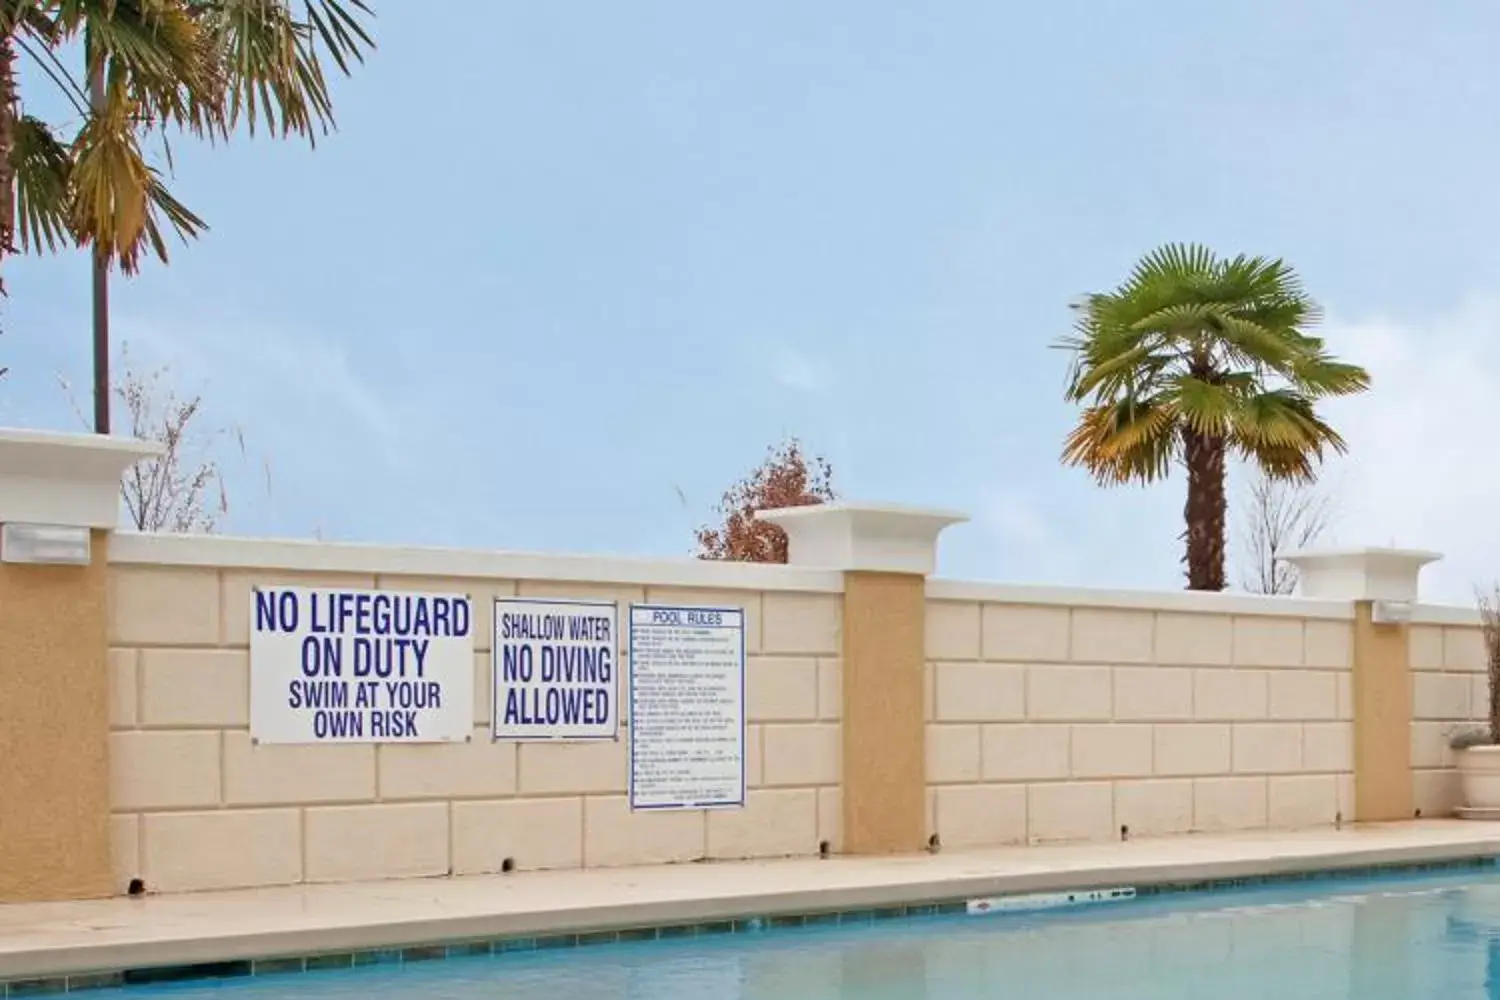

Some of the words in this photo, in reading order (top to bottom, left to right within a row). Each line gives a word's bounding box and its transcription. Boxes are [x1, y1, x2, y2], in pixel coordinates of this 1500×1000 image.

[256, 591, 299, 633] NO
[311, 593, 470, 637] LIFEGUARD
[502, 613, 565, 641] SHALLOW
[570, 616, 611, 642] WATER
[653, 611, 681, 625] POOL
[687, 611, 723, 625] RULES
[302, 635, 342, 677] ON
[354, 638, 429, 678] DUTY
[503, 644, 533, 682] NO
[541, 646, 611, 683] DIVING
[289, 680, 348, 709] SWIM
[355, 681, 379, 709] AT
[386, 682, 441, 709] YOUR
[504, 688, 609, 725] ALLOWED
[314, 710, 363, 738] OWN
[371, 711, 418, 737] RISK
